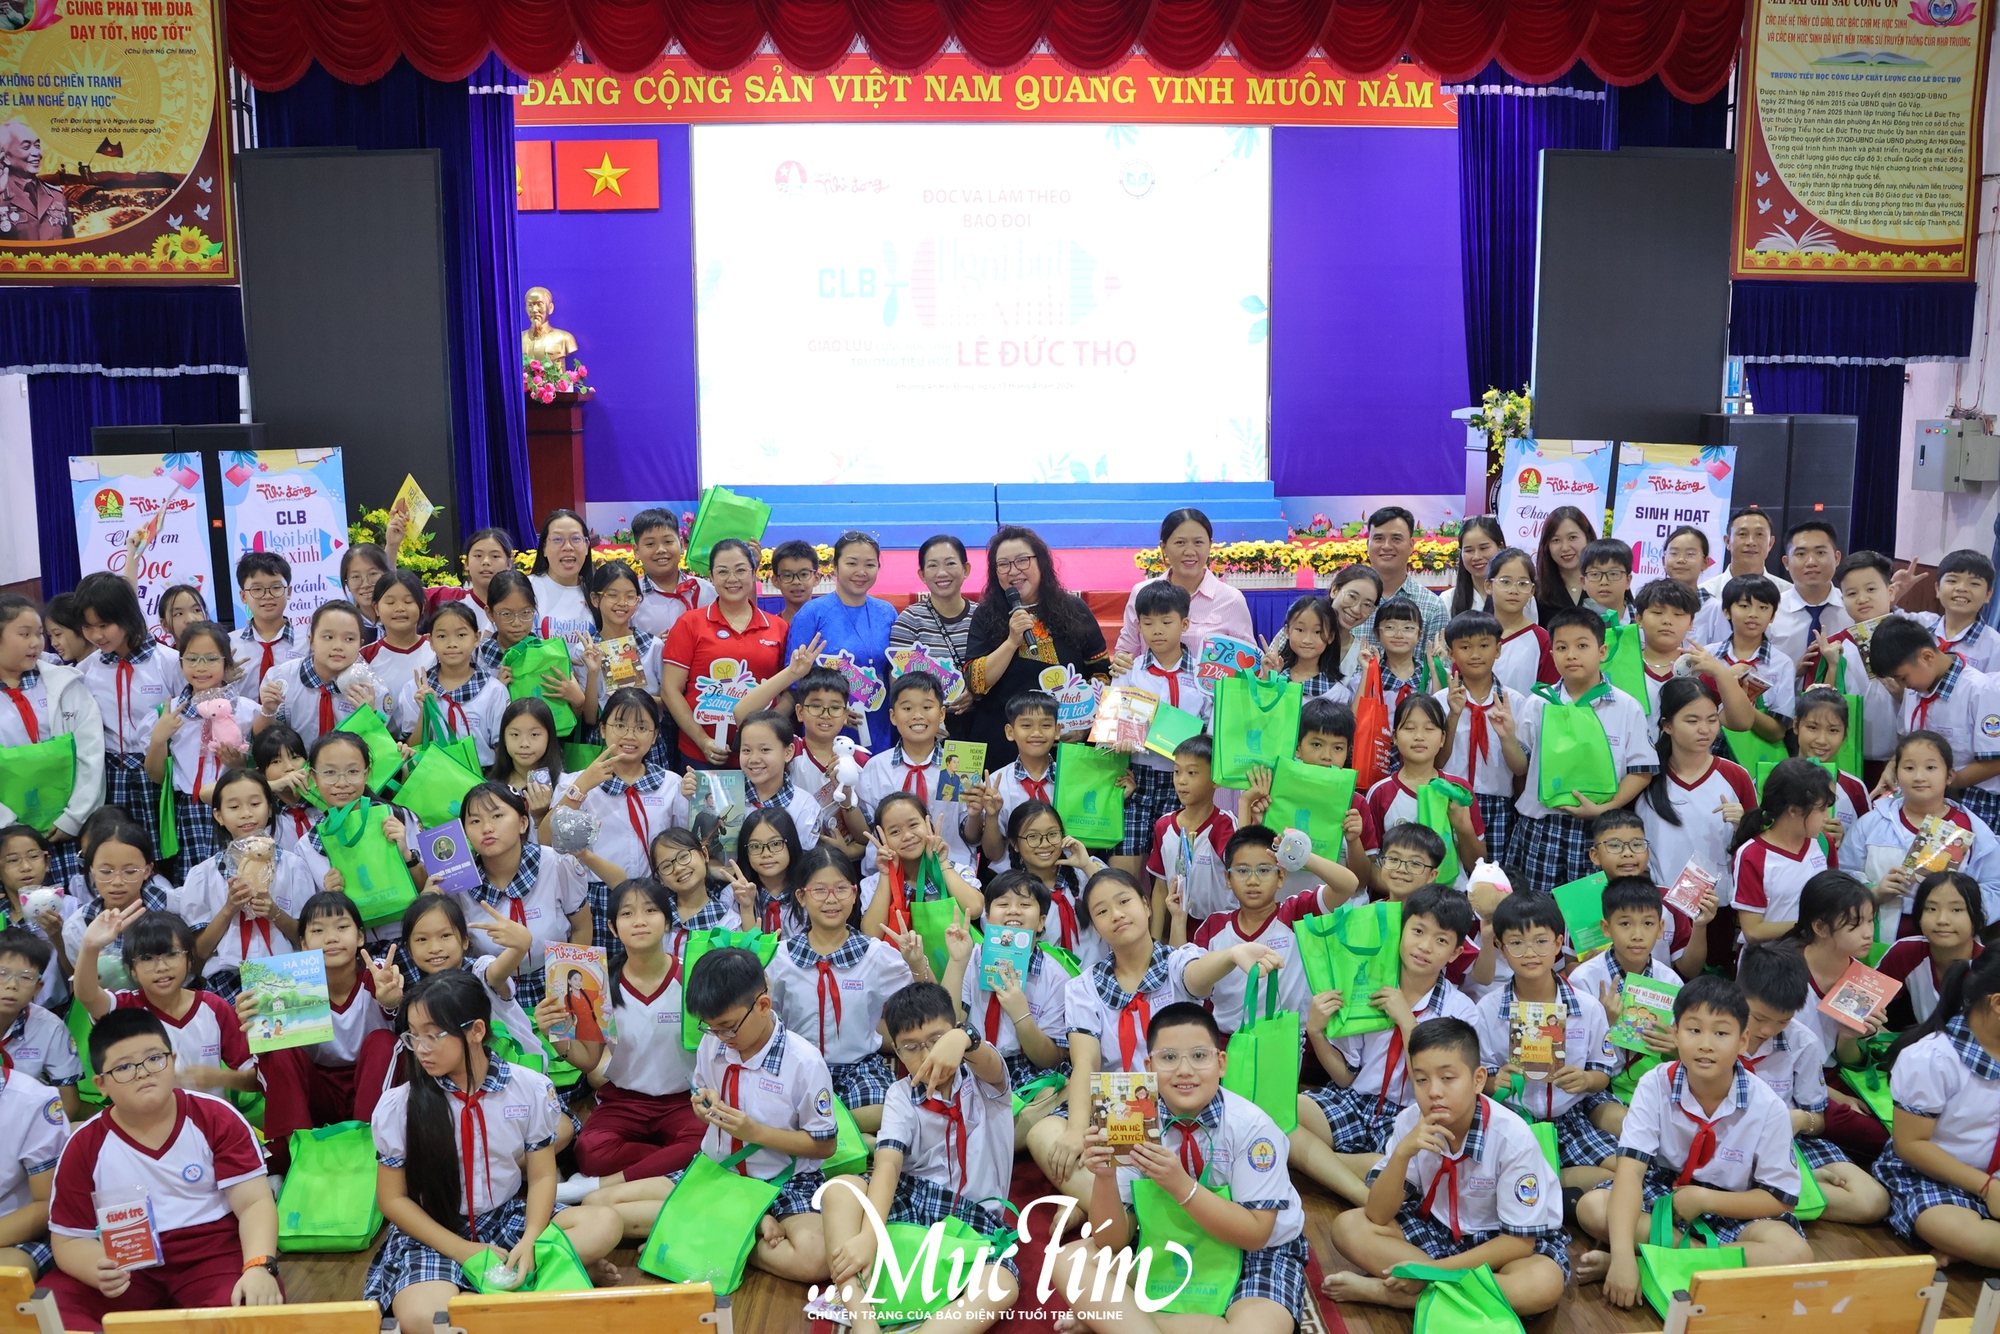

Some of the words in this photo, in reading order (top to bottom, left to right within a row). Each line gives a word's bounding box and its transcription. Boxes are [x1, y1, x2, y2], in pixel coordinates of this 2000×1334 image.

[142, 2, 162, 16] THI
[167, 2, 193, 16] ĐUA
[1766, 15, 1776, 25] CÁC
[1778, 13, 1788, 26] THẾ
[1789, 15, 1795, 27] HỆ
[1812, 16, 1819, 26] CÔ
[1836, 17, 1847, 27] CÁC
[1860, 18, 1872, 28] CHA
[1873, 19, 1880, 30] MẸ
[1882, 19, 1892, 30] HỌC
[1894, 19, 1907, 29] SINH
[70, 25, 95, 43] DẠY
[100, 21, 128, 41] TỐT,
[131, 26, 158, 43] HỌC
[162, 21, 191, 40] TỐT"
[1788, 33, 1796, 42] EM
[1797, 33, 1808, 44] HỌC
[1809, 34, 1822, 43] SINH
[1856, 35, 1874, 44] TRANG
[0, 74, 34, 87] KHÔNG
[38, 72, 50, 87] CÓ
[54, 71, 85, 88] CHIẾN
[87, 76, 122, 88] TRANH
[1816, 73, 1829, 81] HỌC
[522, 68, 621, 105] ĐẢNG
[634, 68, 732, 110] CỘNG
[745, 64, 814, 103] SẢN
[826, 67, 912, 109] VIỆT
[924, 75, 1002, 102] NAM
[1015, 75, 1136, 111] QUANG
[1148, 77, 1234, 104] VINH
[1246, 71, 1346, 106] MUÔN
[1358, 74, 1434, 108] NĂM
[13, 92, 35, 106] LÀM
[38, 92, 65, 106] NGHỀ
[68, 96, 88, 109] DẠY
[91, 96, 116, 109] HỌC"
[1027, 189, 1071, 204] THEO
[818, 268, 876, 298] CLB
[808, 340, 842, 352] GIAO
[958, 334, 990, 366] LÊ
[998, 334, 1065, 366] ĐỨC
[1073, 340, 1136, 374] THỌ
[256, 484, 284, 501] Nhi
[1546, 478, 1570, 492] Nhi
[1648, 478, 1674, 492] Nhi
[130, 497, 160, 514] Nhi
[277, 510, 306, 525] CLB
[1635, 506, 1669, 520] SINH
[1674, 509, 1710, 525] HOẠT
[161, 532, 180, 544] em
[263, 530, 294, 553] Ngòi
[298, 528, 320, 545] bút
[290, 545, 320, 564] xinh
[294, 574, 327, 594] cánh
[290, 598, 311, 611] câu
[549, 616, 571, 634] Ngòi
[930, 609, 942, 629] adidas
[944, 636, 956, 655] adidas
[1208, 642, 1235, 664] Tớ
[1203, 663, 1228, 680] Văn
[706, 696, 733, 712] sáng
[1060, 692, 1081, 703] thích
[1058, 706, 1069, 719] ng
[1072, 704, 1089, 716] tác
[550, 946, 571, 959] Nhi
[283, 958, 298, 970] HÀ
[300, 955, 320, 967] NỘI
[292, 968, 309, 977] của
[1524, 1044, 1538, 1052] MÙA
[1110, 1124, 1128, 1132] MÙA
[1108, 1133, 1118, 1141] CÓ
[1121, 1132, 1144, 1141] TUYẾT
[1196, 1285, 1218, 1296] NAM
